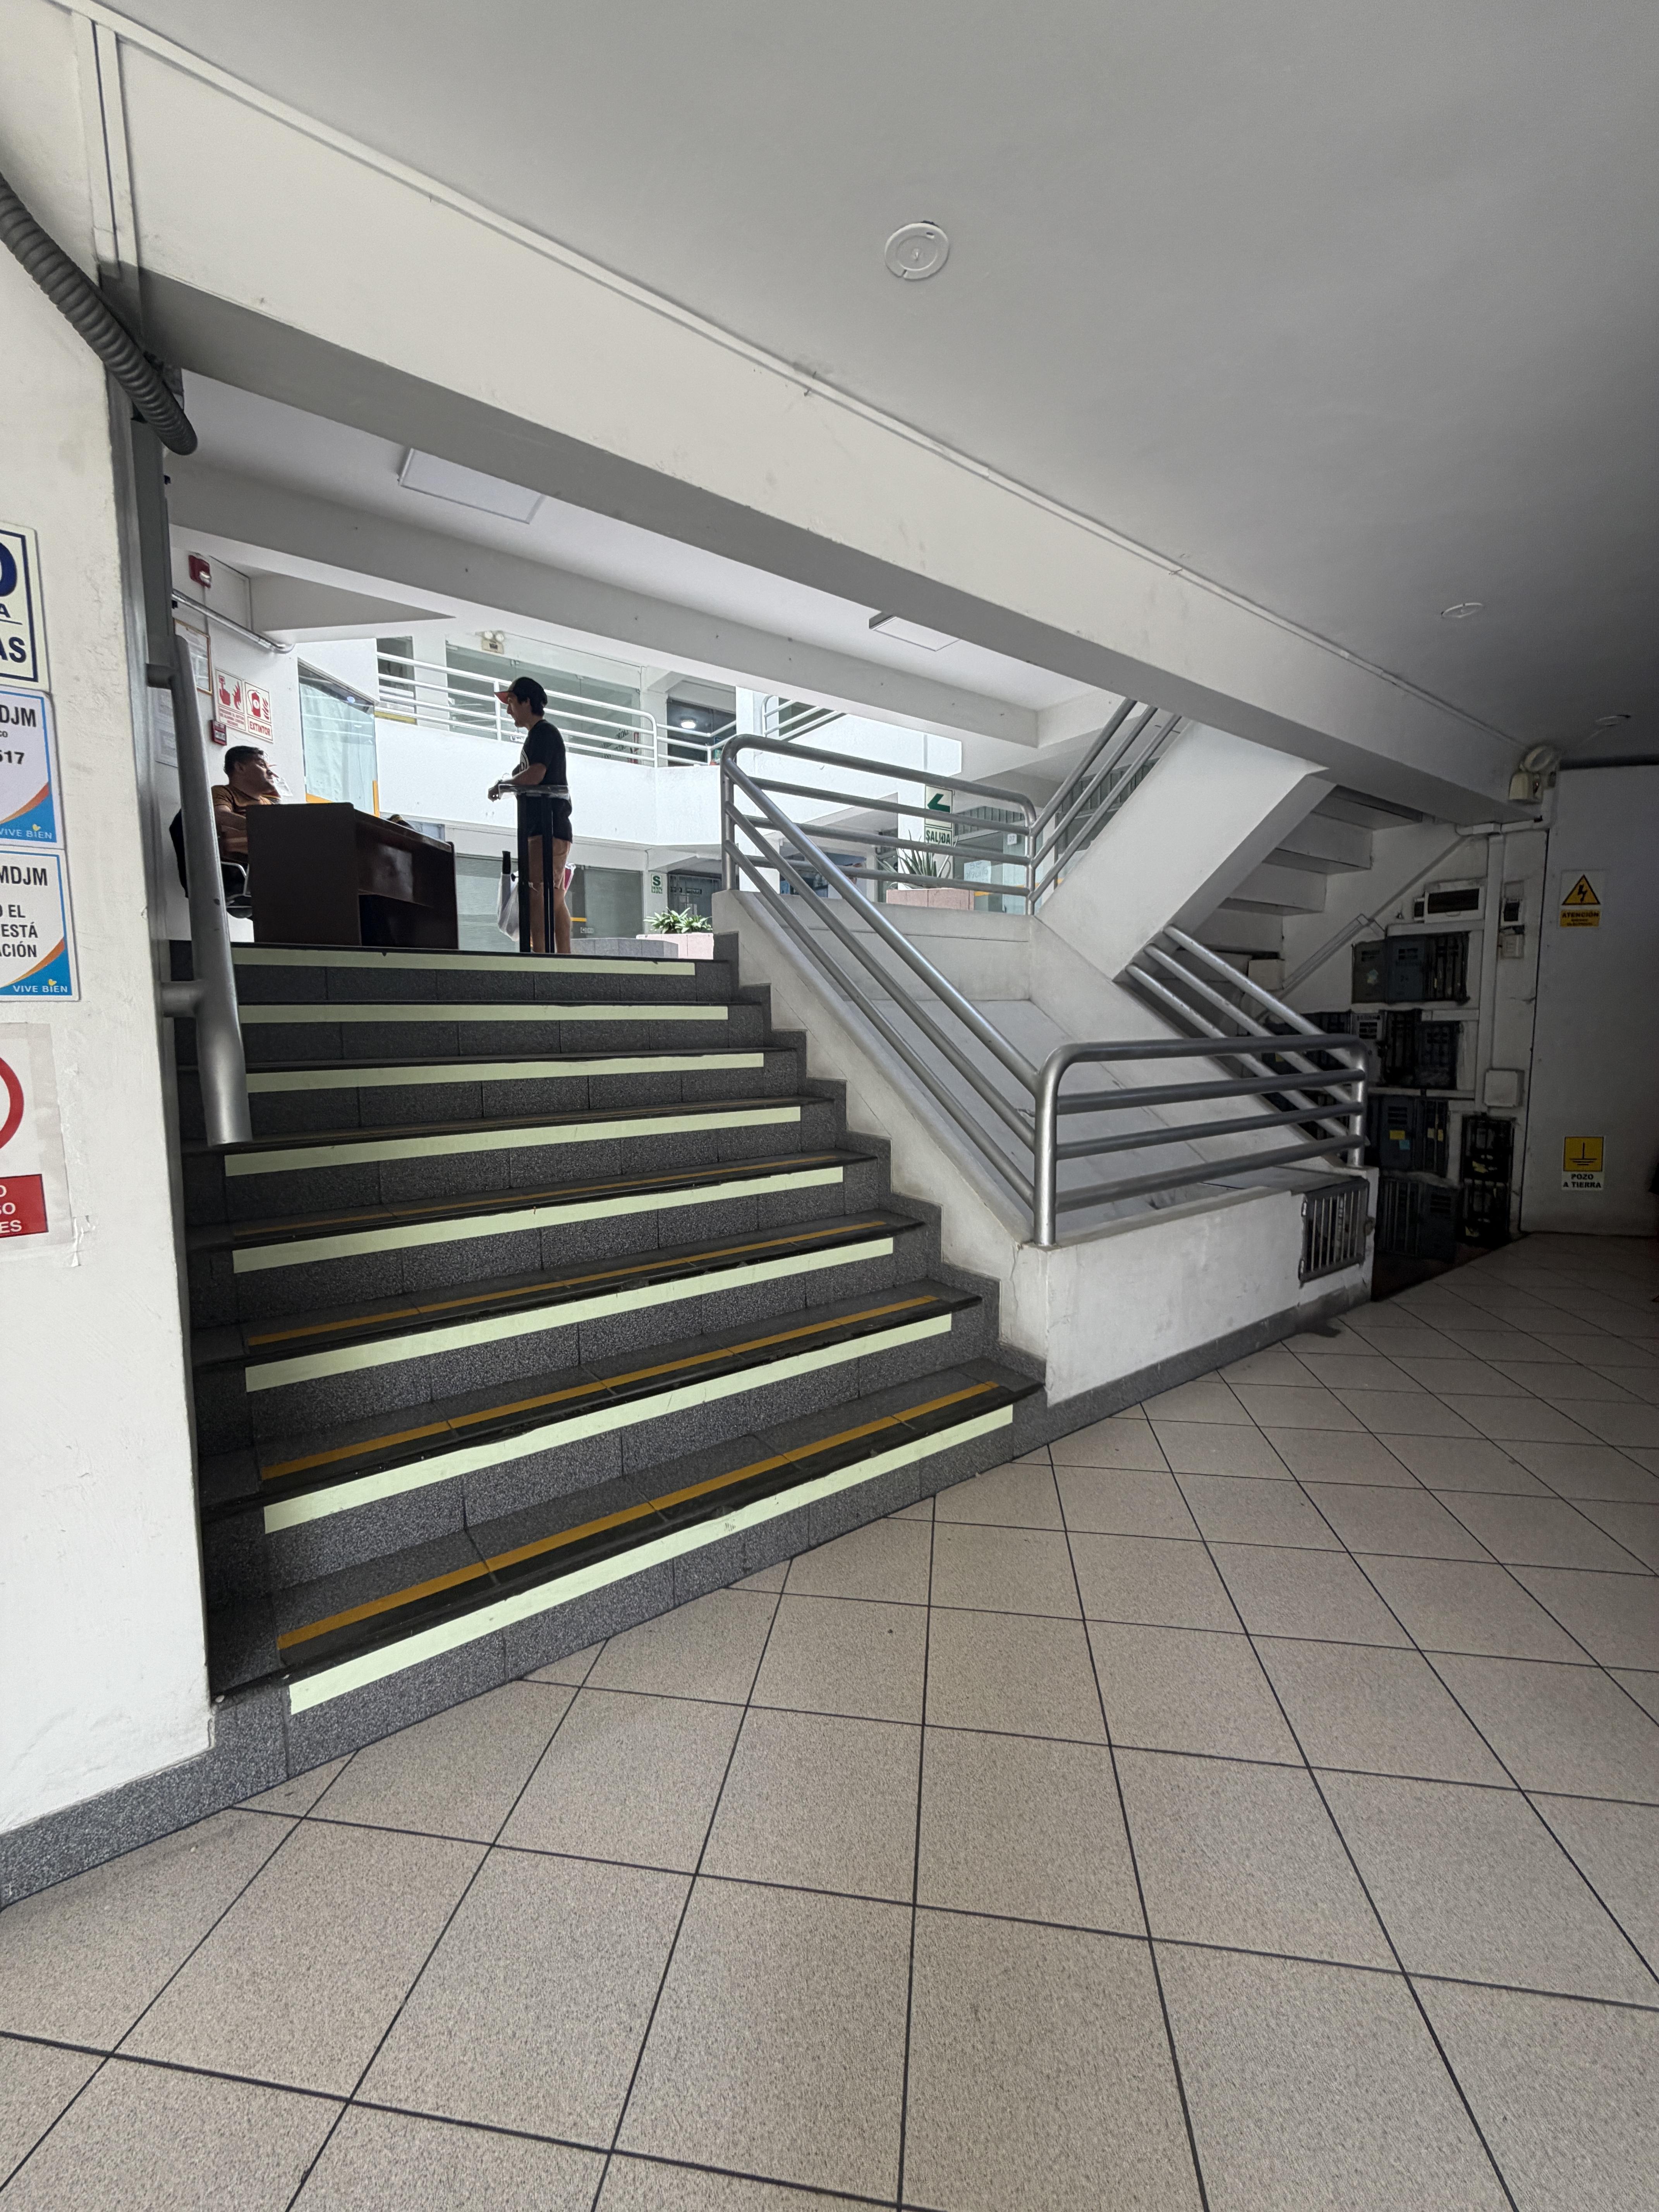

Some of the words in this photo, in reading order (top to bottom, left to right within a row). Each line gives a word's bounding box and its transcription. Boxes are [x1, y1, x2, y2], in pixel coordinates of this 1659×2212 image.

[249, 721, 271, 736] EXTINTOR
[26, 830, 52, 840] BIEN
[926, 830, 950, 845] SALIDA
[653, 875, 661, 886] S
[8, 904, 26, 918] EL
[1, 922, 38, 938] ESTÁ
[0, 941, 37, 957] CIÓN
[0, 1202, 16, 1215] O
